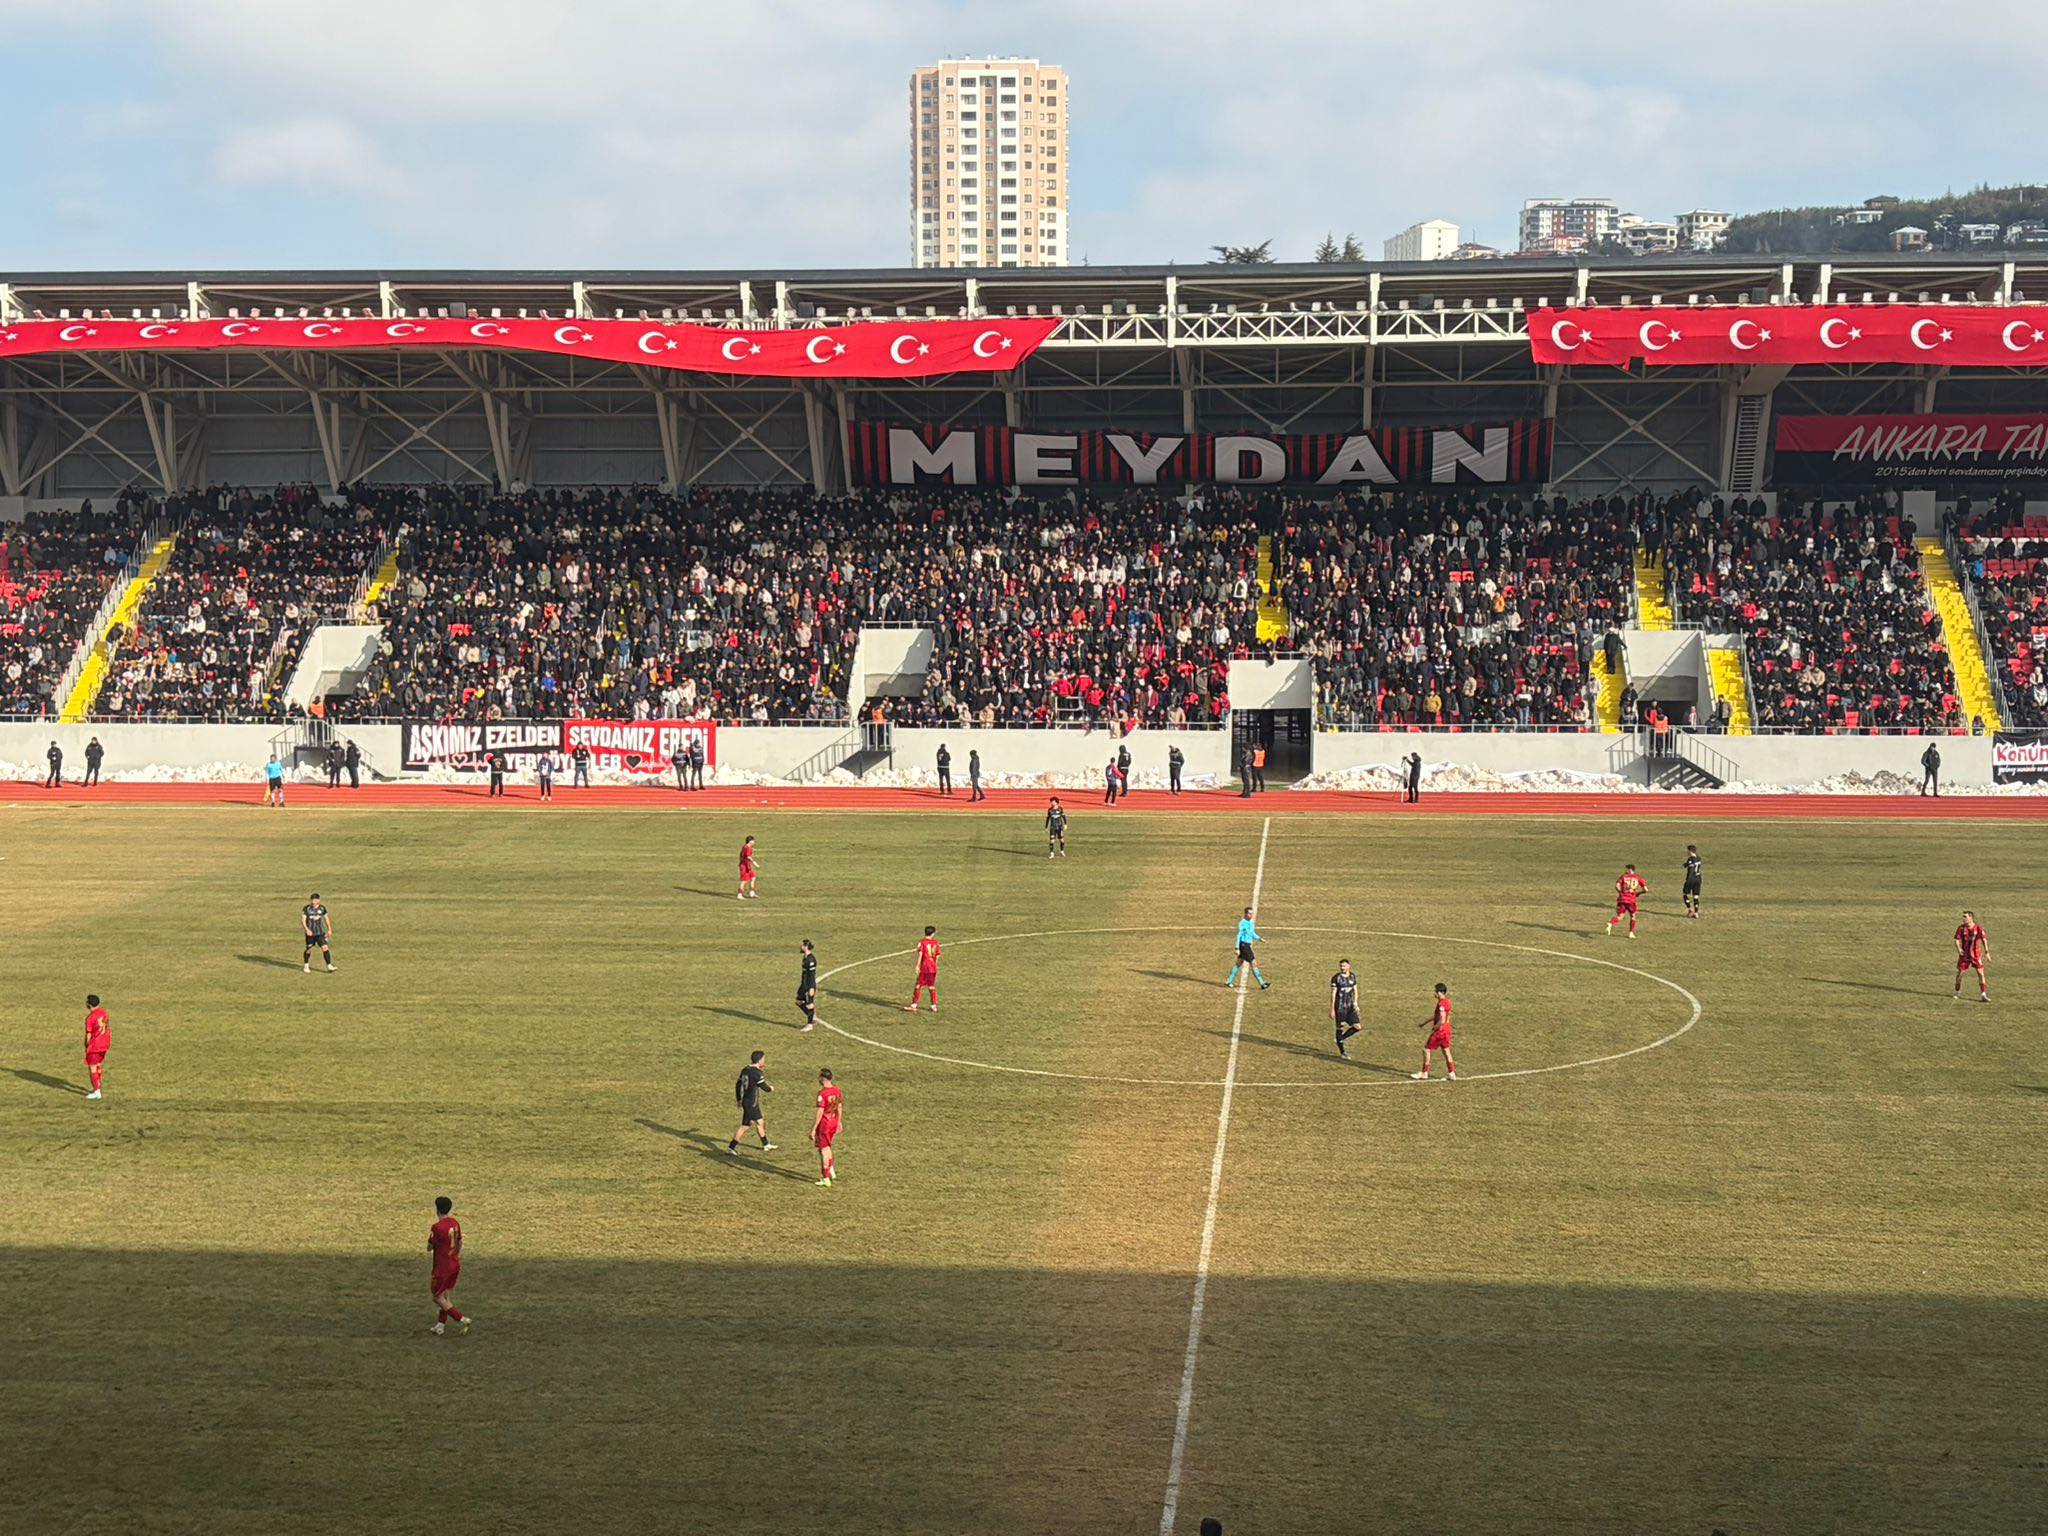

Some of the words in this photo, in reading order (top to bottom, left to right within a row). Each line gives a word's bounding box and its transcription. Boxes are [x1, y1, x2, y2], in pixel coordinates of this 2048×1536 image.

[889, 426, 1510, 484] MEYDAN
[1832, 424, 1988, 462] ANKARA
[409, 724, 482, 763] AŞKIMIZ
[485, 726, 560, 749] EZELDEN
[569, 725, 655, 754] SEVDAMIZ
